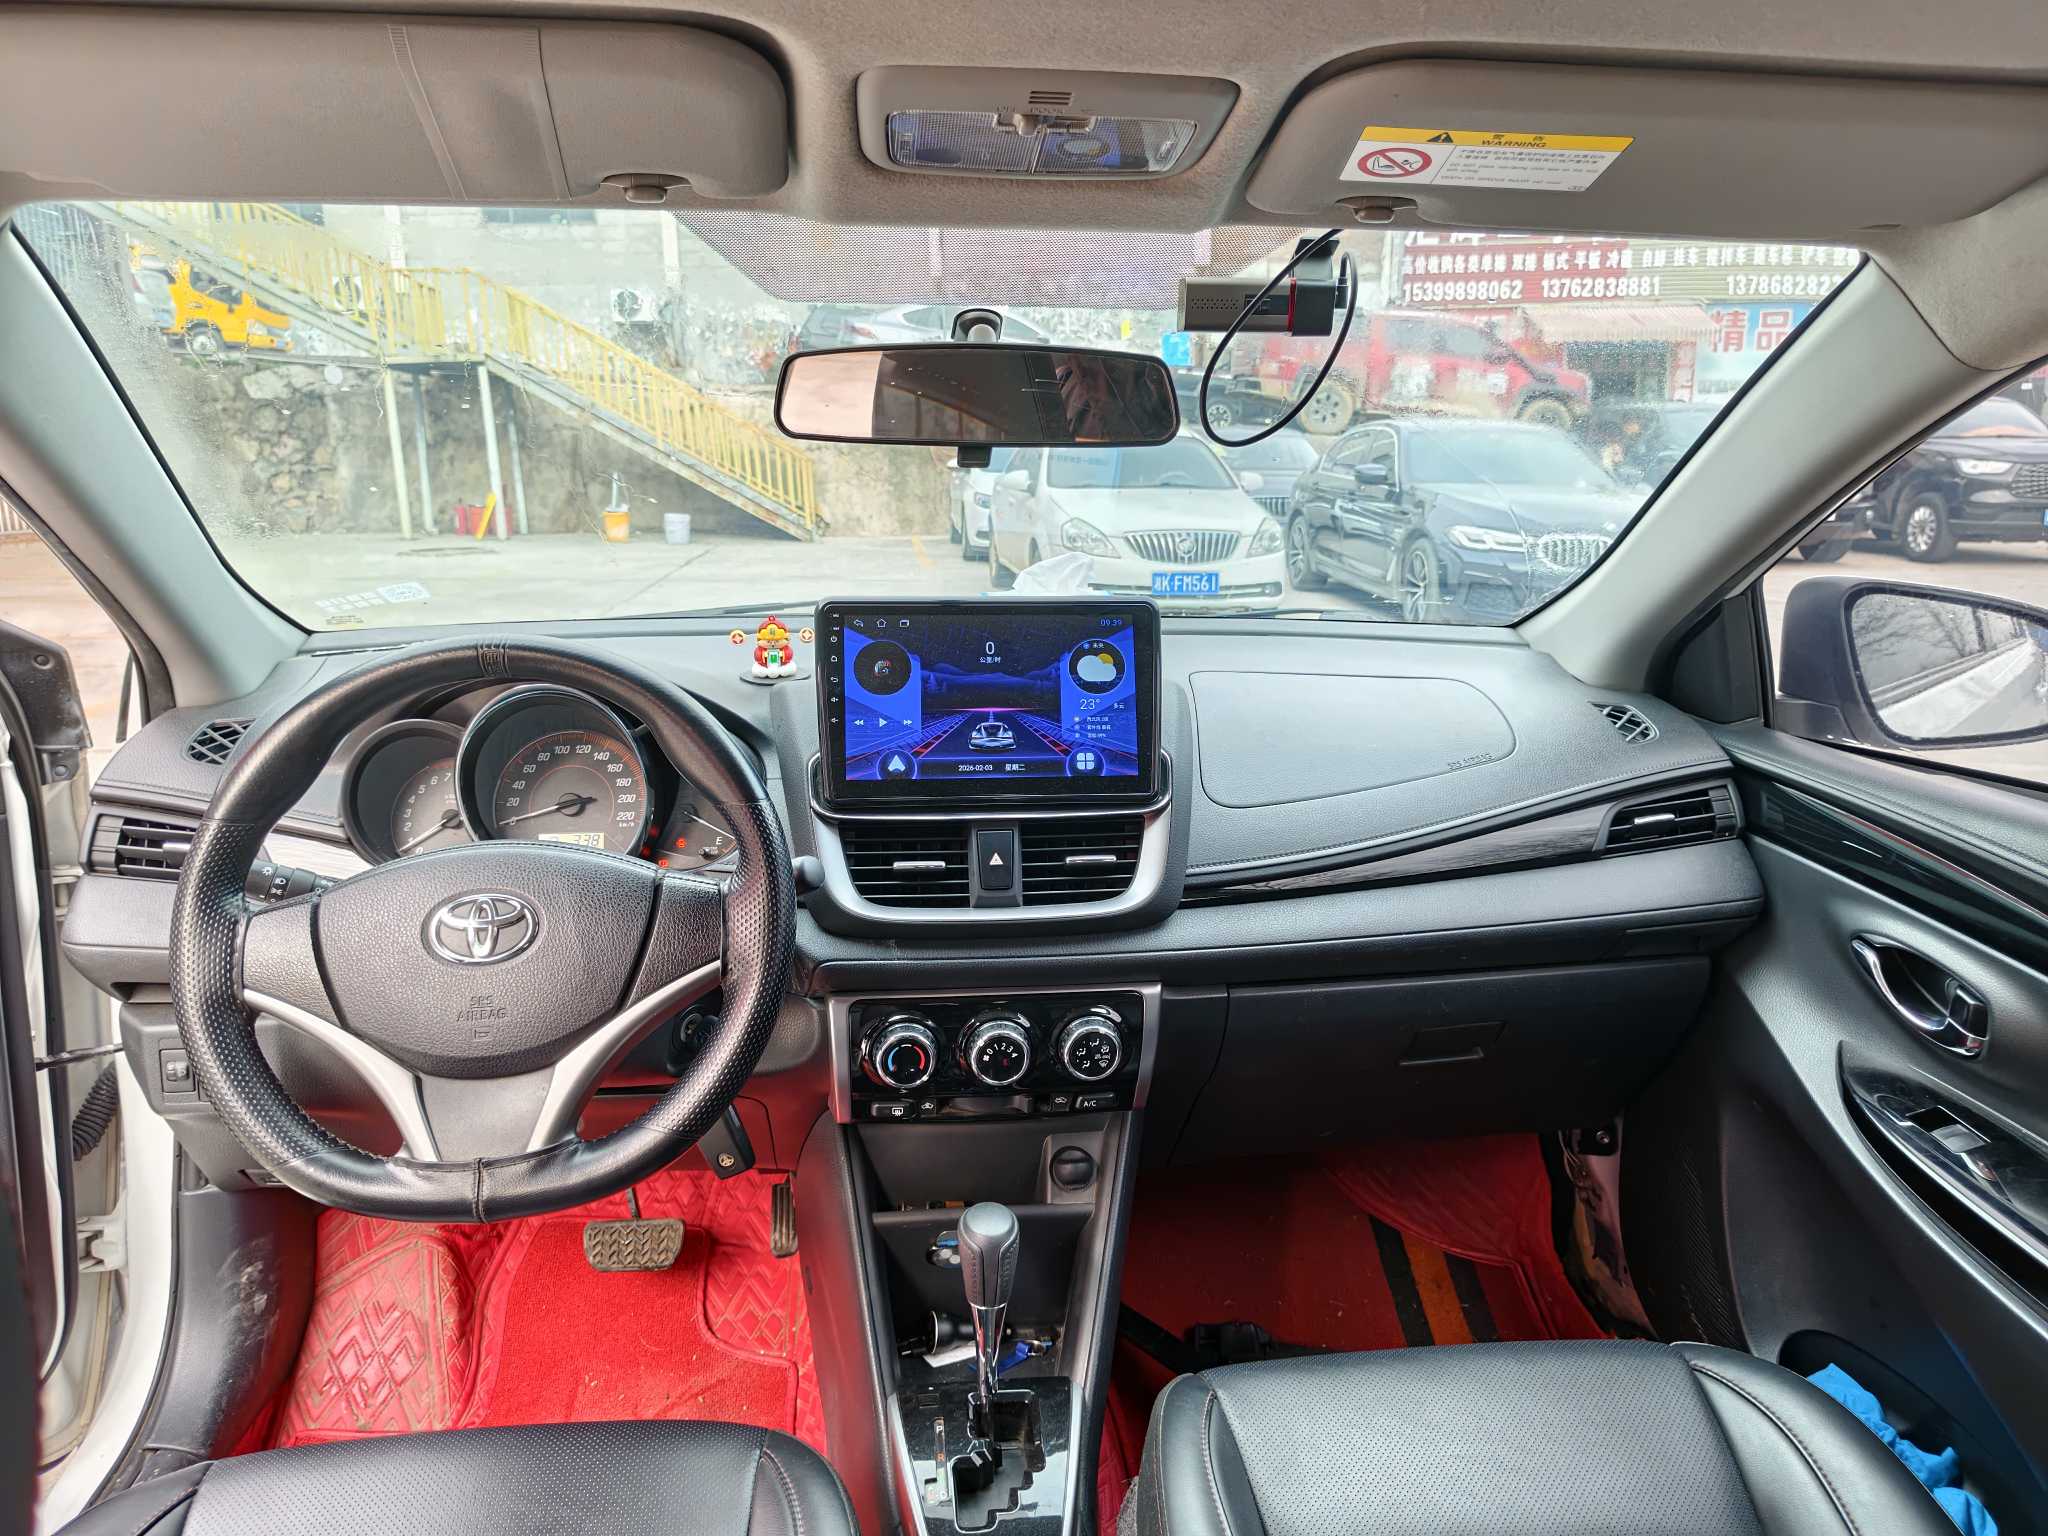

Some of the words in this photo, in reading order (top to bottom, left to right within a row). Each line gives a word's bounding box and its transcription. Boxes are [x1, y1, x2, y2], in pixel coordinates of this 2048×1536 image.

[1480, 139, 1547, 148] WARNING
[1402, 280, 1523, 303] 15399898062
[1541, 275, 1660, 298] 13762838881
[1710, 309, 1791, 353] 精品
[985, 641, 995, 655] 0
[554, 745, 570, 754] 100
[575, 744, 592, 754] 120
[537, 752, 550, 761] 80
[593, 751, 610, 761] 140
[523, 764, 537, 773] 60
[607, 763, 623, 773] 160
[958, 764, 993, 772] 2026-02-03
[1005, 763, 1026, 771] 星期二
[431, 776, 439, 785] 6
[444, 772, 451, 782] 7
[616, 777, 632, 787] 180
[417, 784, 427, 794] 5
[512, 780, 526, 790] 40
[506, 797, 520, 807] 20
[617, 794, 636, 803] 200
[403, 808, 412, 818] 3
[616, 811, 635, 821] 220
[403, 822, 412, 831] 2
[715, 836, 723, 845] E
[994, 1043, 999, 1051] 1
[1000, 1042, 1007, 1051] 2
[1006, 1045, 1014, 1053] 3
[1083, 1100, 1097, 1108] A/C
[935, 1452, 945, 1461] R
